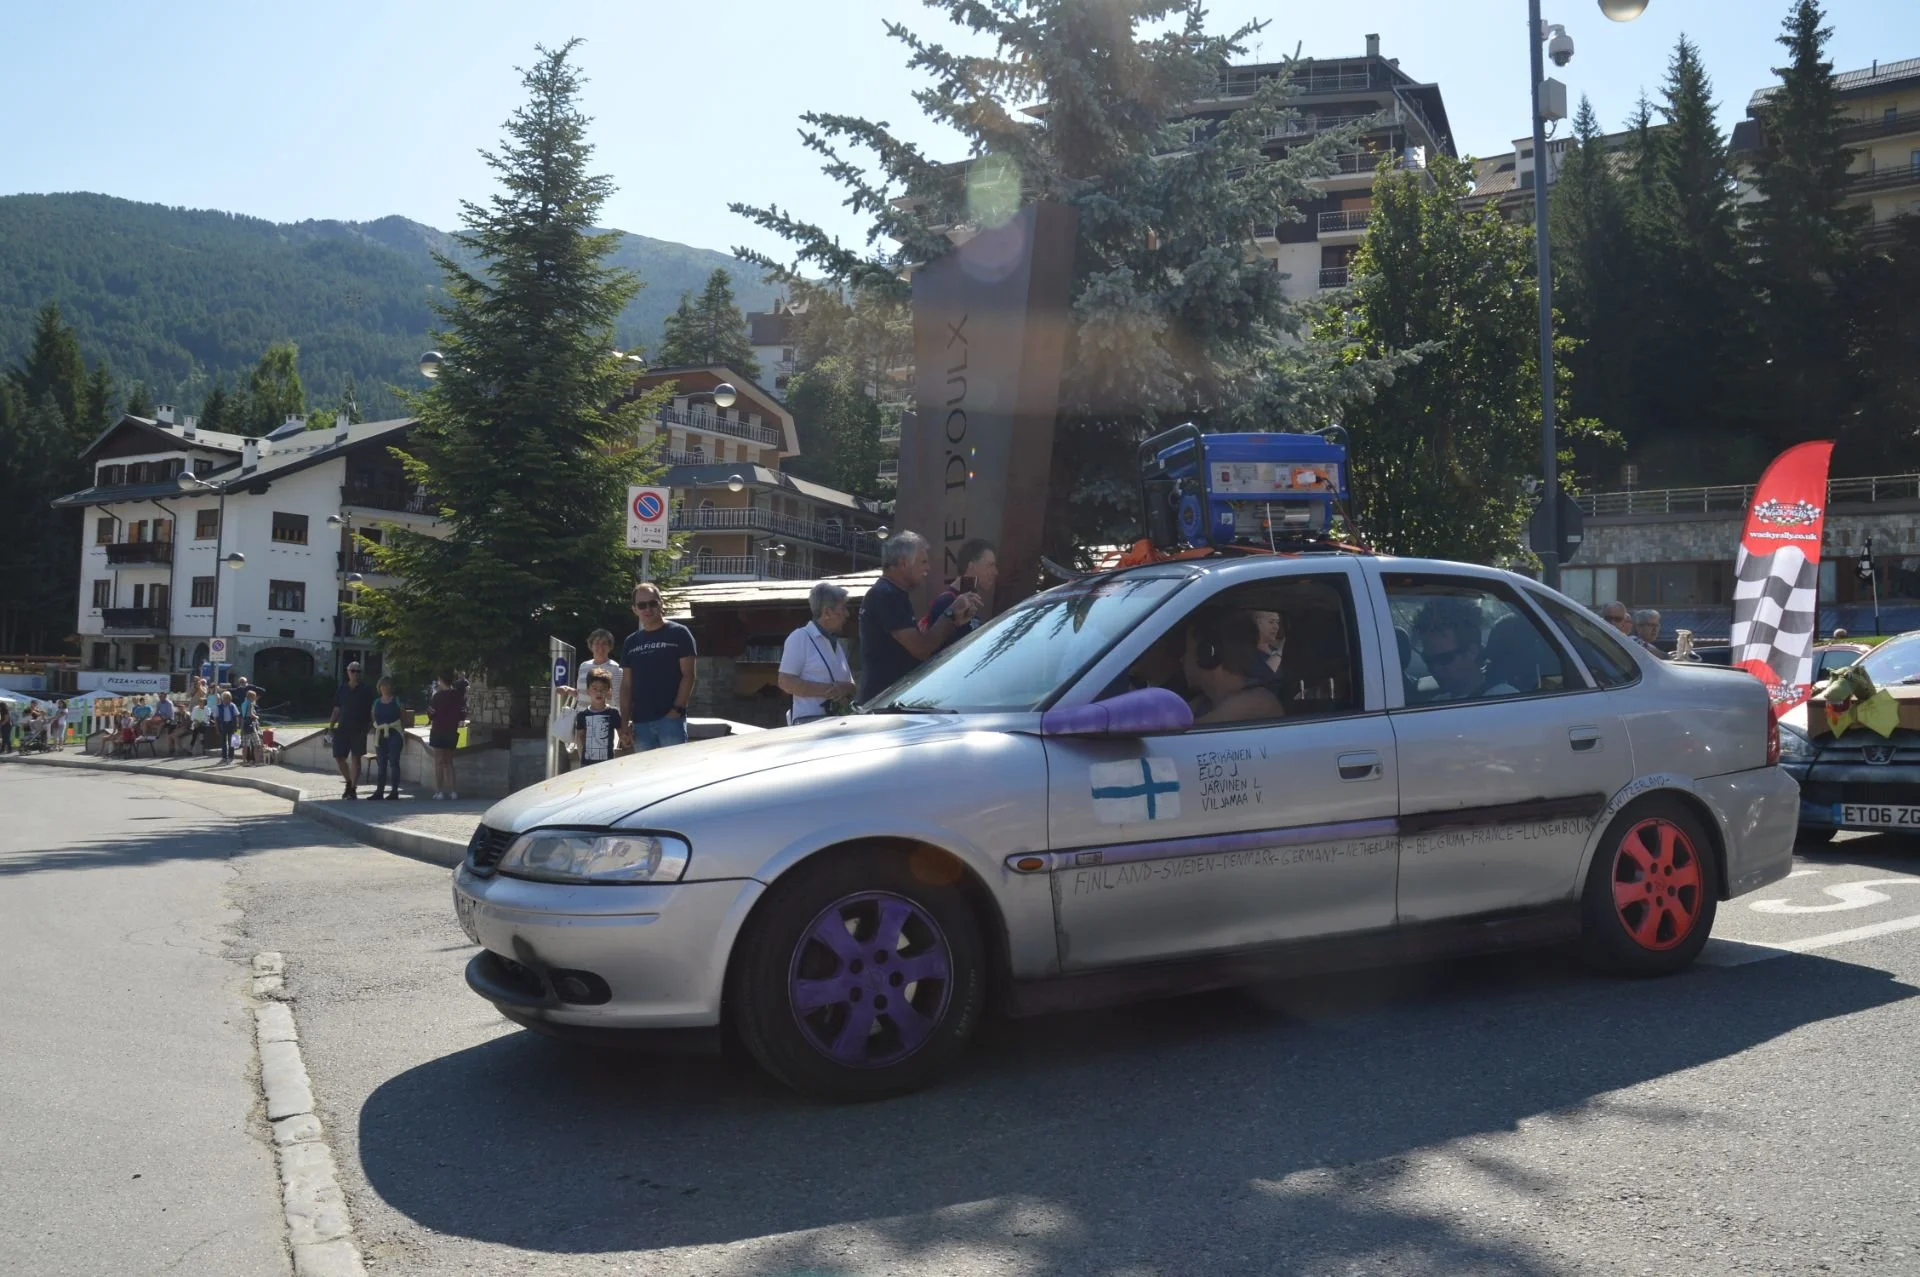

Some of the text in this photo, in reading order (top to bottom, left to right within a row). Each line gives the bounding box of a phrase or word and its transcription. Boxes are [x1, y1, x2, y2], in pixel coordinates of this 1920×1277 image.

[945, 313, 968, 496] D'OULX
[1749, 531, 1817, 540] wackyrally.co.uk
[556, 666, 566, 680] P
[1199, 763, 1238, 781] ELO J
[1844, 806, 1891, 823] ET06
